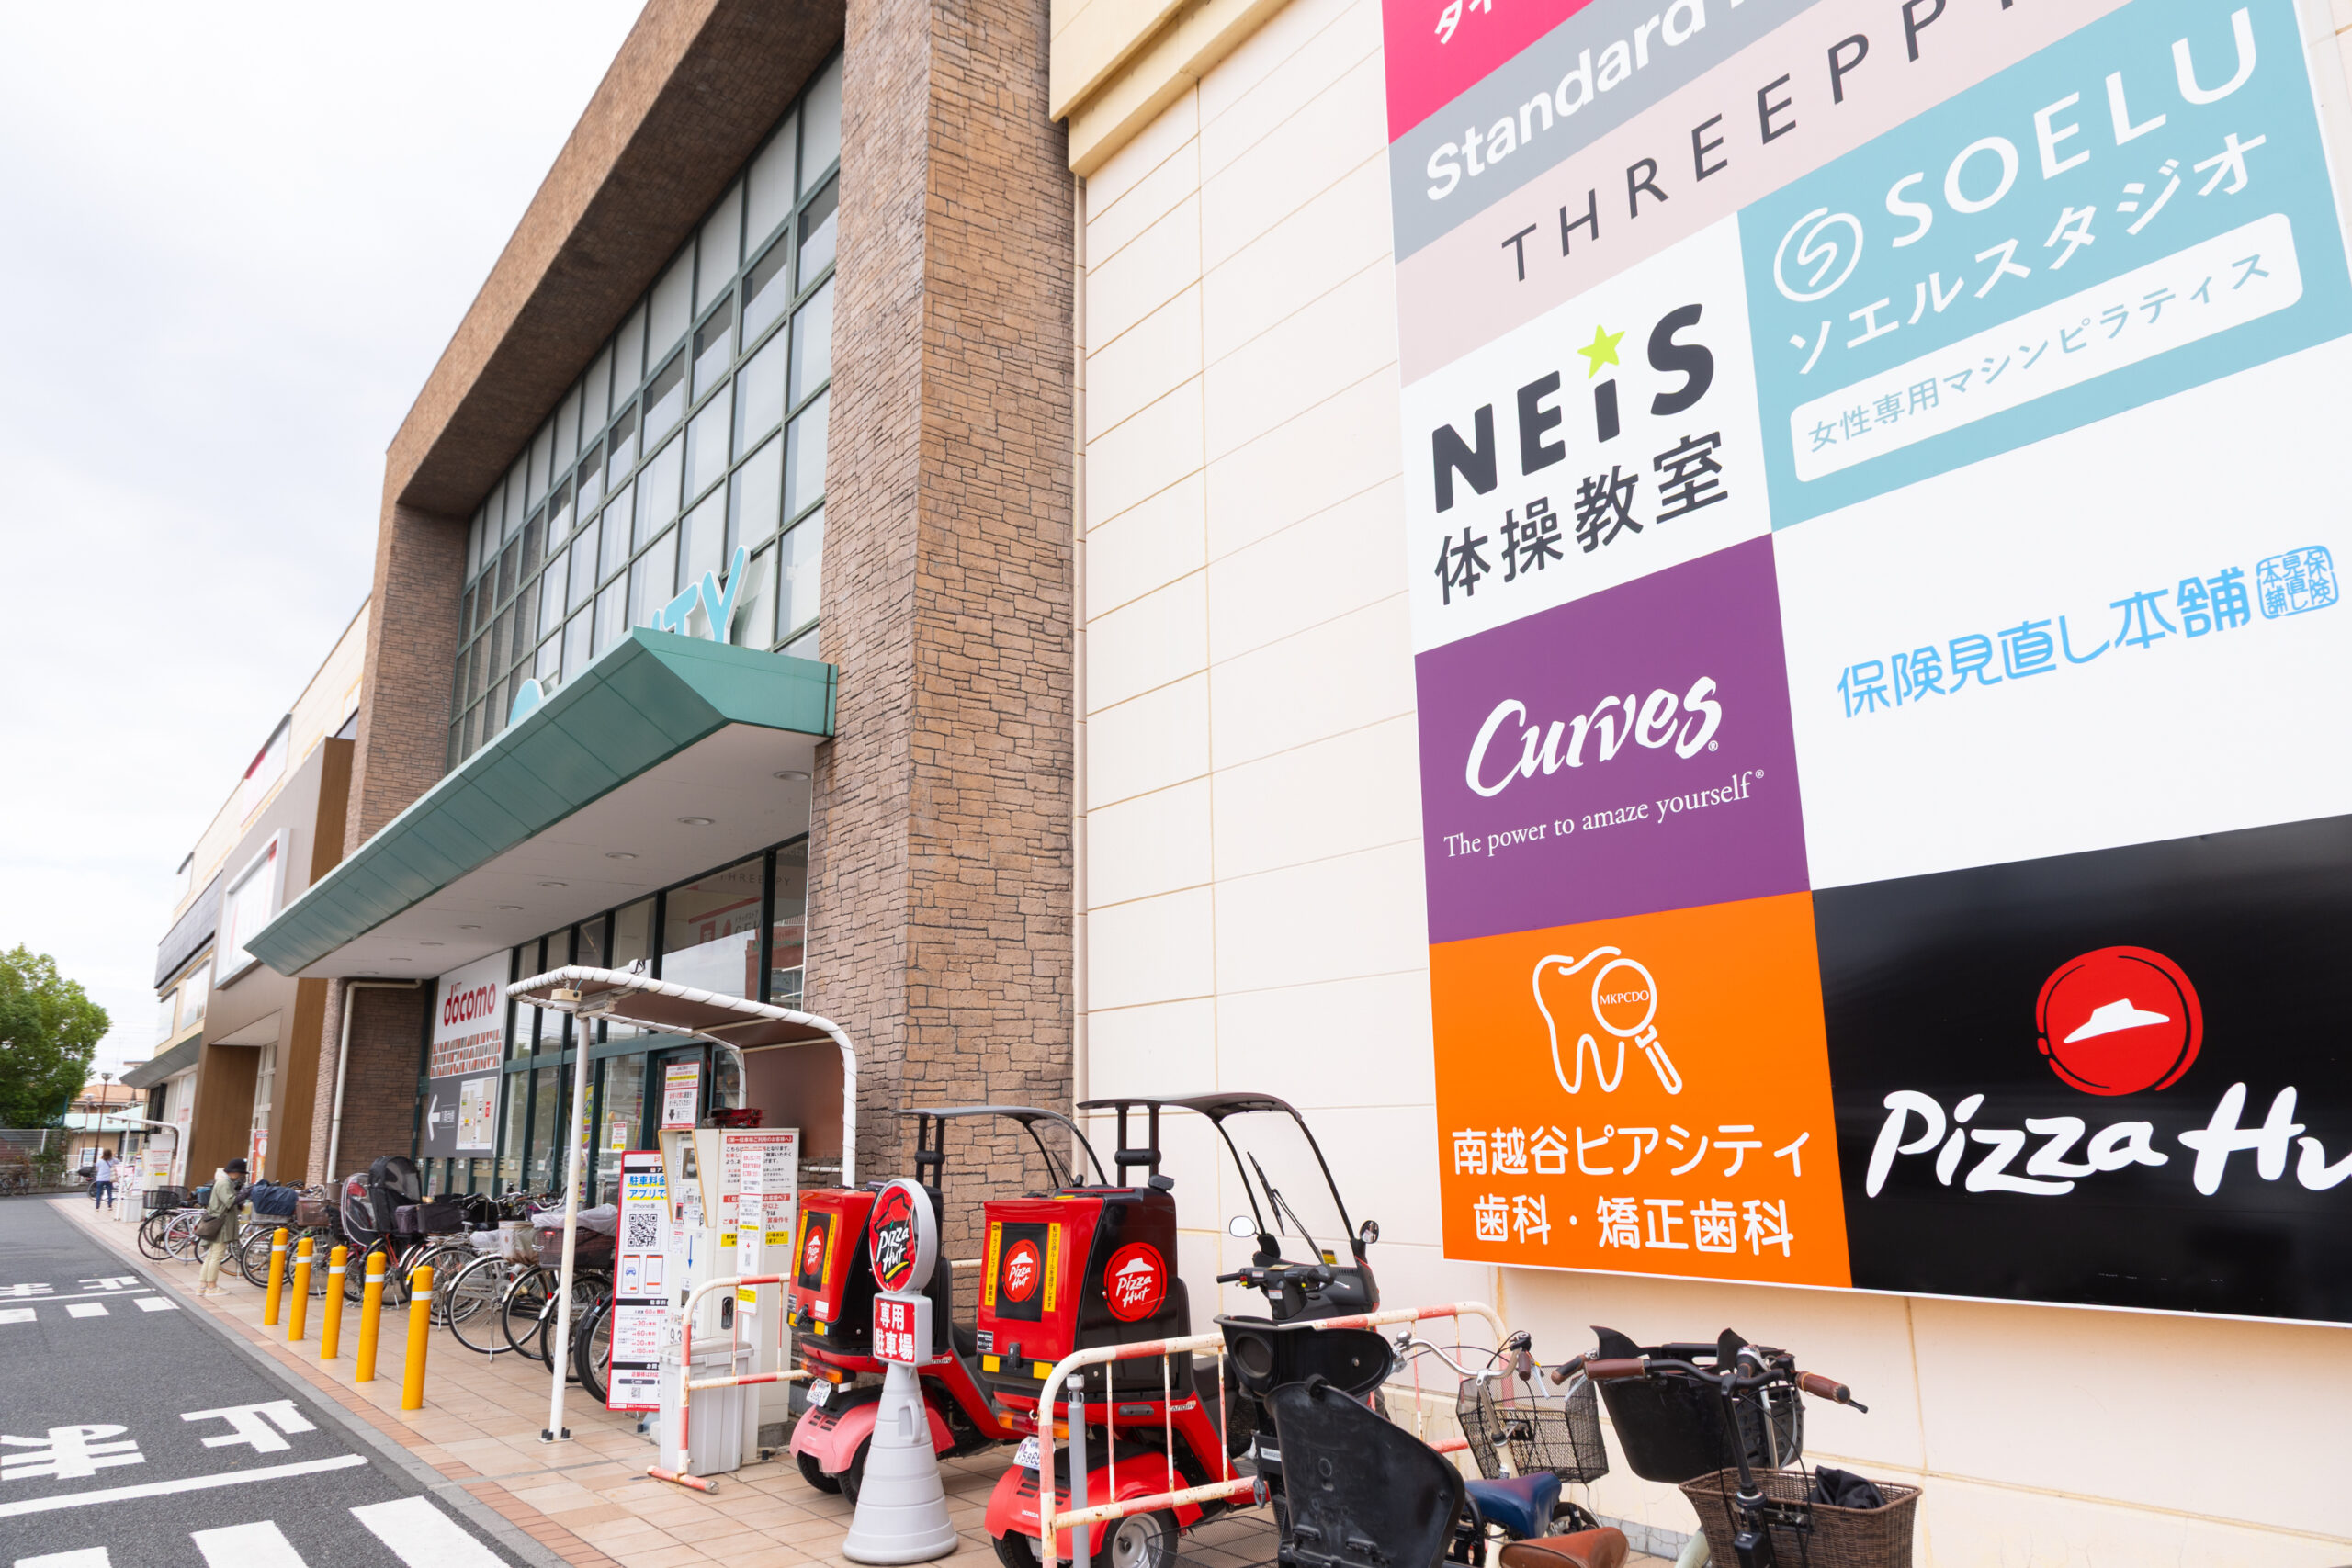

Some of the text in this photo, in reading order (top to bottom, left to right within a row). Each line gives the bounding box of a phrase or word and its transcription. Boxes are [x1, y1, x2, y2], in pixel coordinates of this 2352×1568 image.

[1426, 0, 1707, 201] Standard
[1885, 7, 2258, 248] SOELU
[1501, 0, 2014, 283] THREEPP
[1789, 132, 2267, 376] ソエルスタジオ
[1807, 251, 2271, 454] 女性専用マシンピラティス
[1434, 432, 1729, 605] 体操教室
[1838, 566, 2252, 718] 保険見直し本舗
[1443, 831, 1481, 858] The
[1487, 822, 1547, 858] power
[1554, 816, 1575, 837] to
[1582, 803, 1649, 832] amaze
[443, 982, 497, 1027] docomo
[1599, 988, 1650, 1009] MKPCDO
[1452, 1124, 1812, 1179] 南越谷ピアシティ
[1866, 1089, 2169, 1199] Pizza
[876, 1221, 910, 1263] Pizza
[1473, 1194, 1795, 1258] 歯科・矯正歯科
[882, 1245, 907, 1273] Hut
[1008, 1264, 1032, 1282] Pizza
[1012, 1275, 1030, 1292] Hut
[1115, 1273, 1153, 1298] Pizza
[880, 1301, 905, 1331] 専用
[1122, 1286, 1152, 1309] Hut
[876, 1328, 914, 1361] 駐車場
